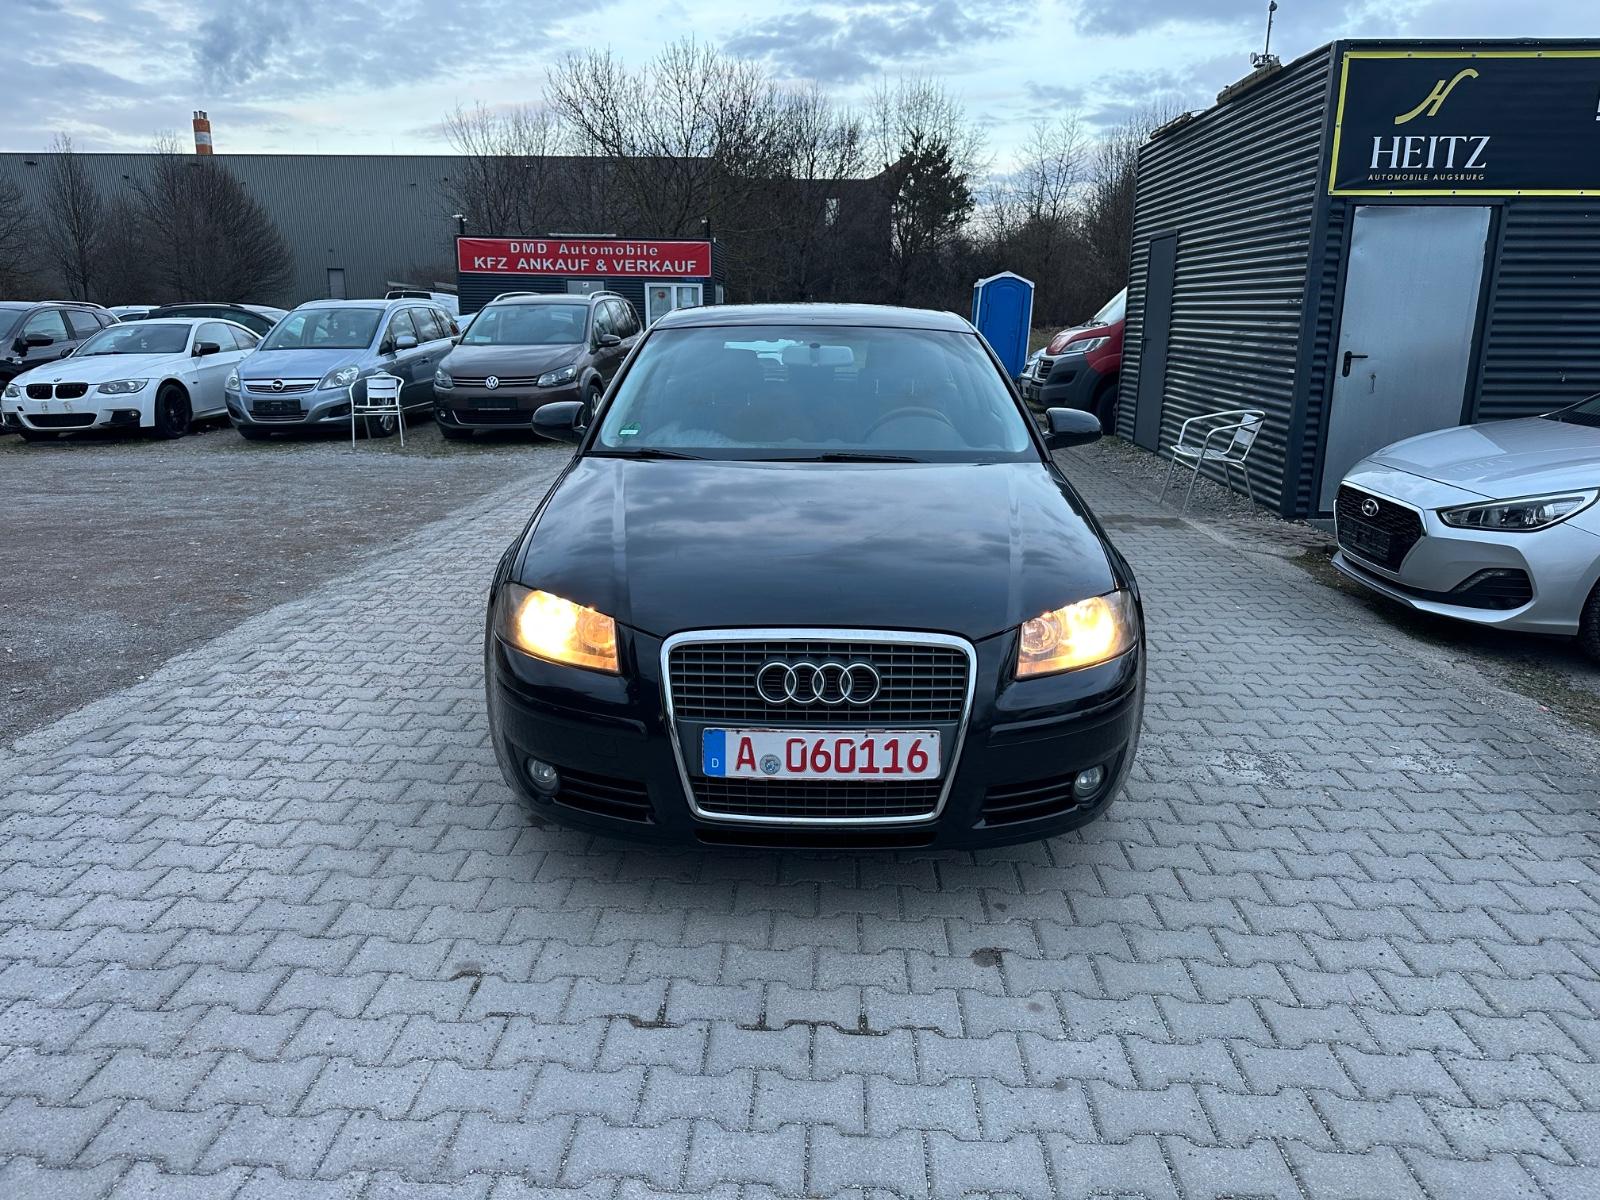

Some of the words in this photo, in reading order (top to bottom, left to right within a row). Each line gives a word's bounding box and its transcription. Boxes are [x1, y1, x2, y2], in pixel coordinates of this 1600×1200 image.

[1369, 135, 1491, 169] HEITZ
[1368, 173, 1429, 181] AUTOMOBILE
[1432, 173, 1485, 181] AUGSBURG
[510, 242, 548, 254] DMD
[559, 243, 659, 256] Automobile
[474, 256, 508, 269] KFZ
[517, 257, 591, 272] ANKAUF
[595, 259, 608, 272] &
[612, 259, 697, 273] VERKAUF
[711, 757, 719, 768] D
[735, 736, 757, 772] A
[785, 737, 929, 774] 060116
